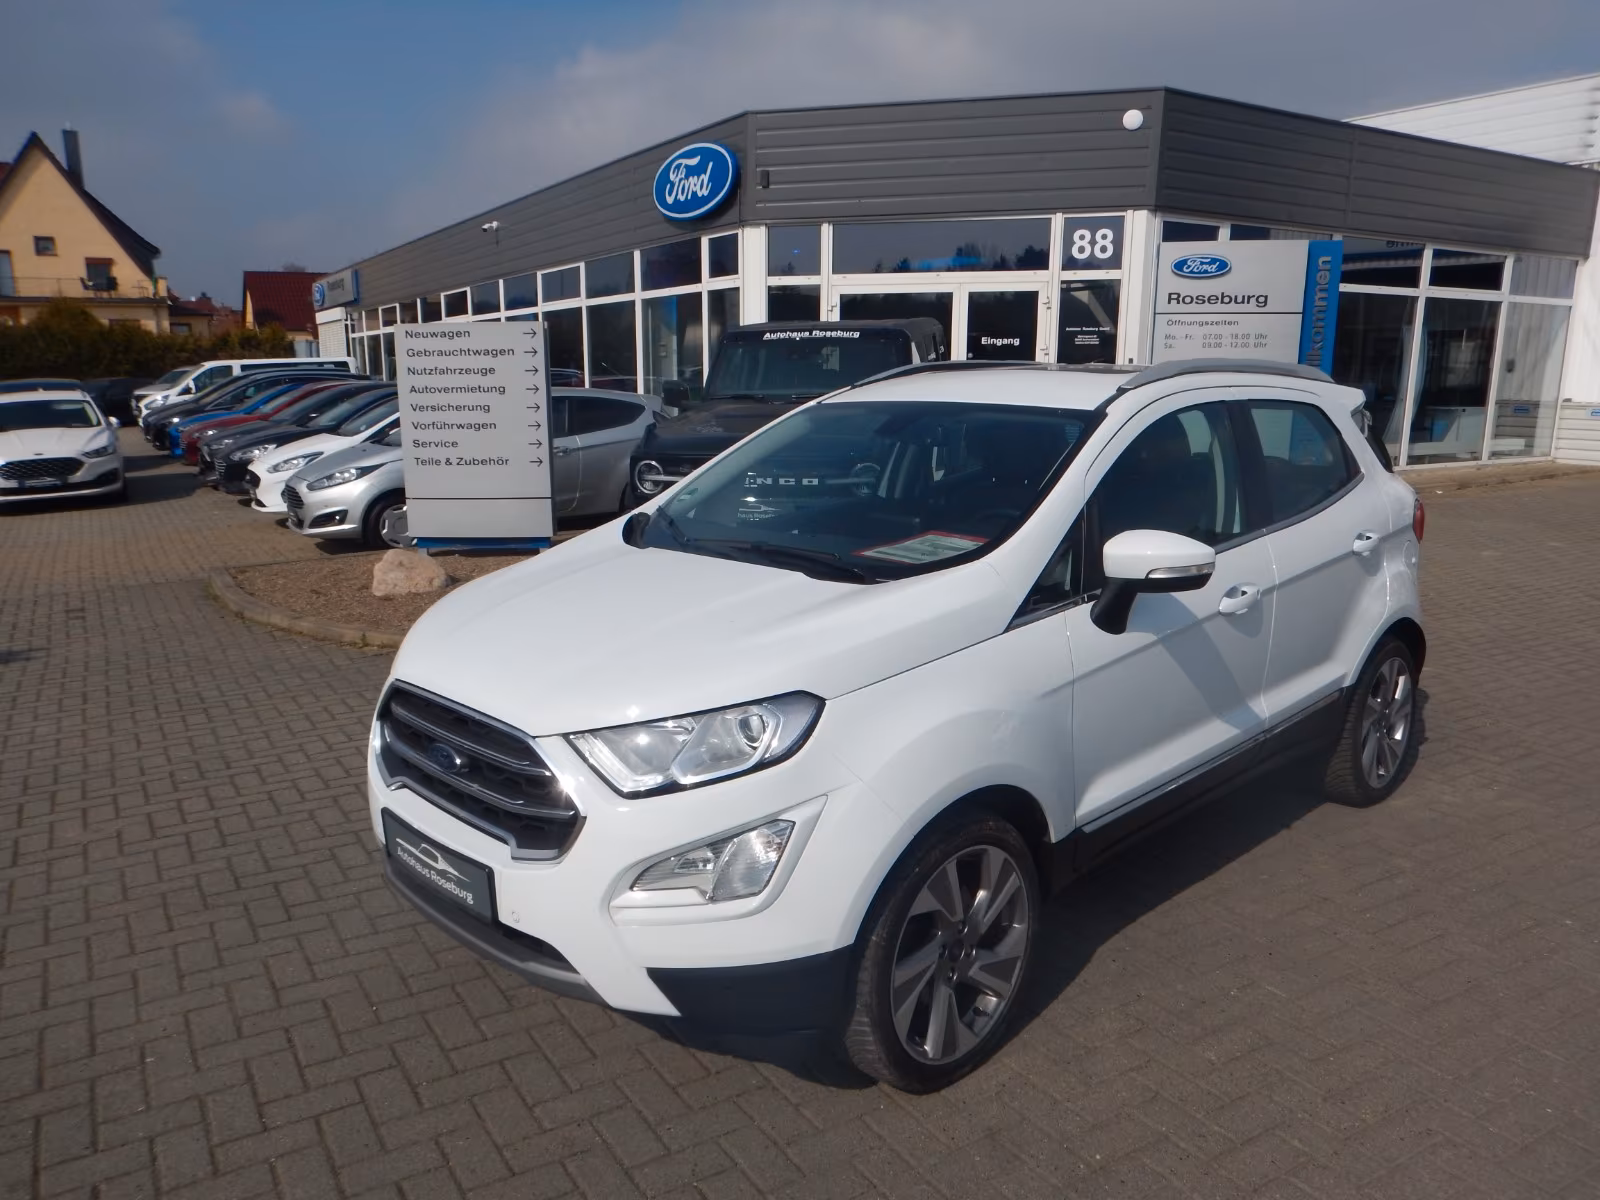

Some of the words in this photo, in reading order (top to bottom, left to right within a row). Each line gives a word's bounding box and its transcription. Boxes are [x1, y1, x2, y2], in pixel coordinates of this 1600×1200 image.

[665, 155, 714, 205] Ford
[1071, 228, 1114, 260] 88
[1183, 257, 1220, 273] Ford
[1167, 292, 1269, 308] Roseburg
[1166, 319, 1239, 327] Öffnungszeiten
[404, 329, 471, 340] Neuwagen
[763, 331, 810, 340] Autohaus
[812, 330, 860, 338] Roseburg
[981, 336, 1020, 346] Eingang
[406, 347, 515, 358] Gebrauchtwagen
[407, 366, 496, 376] Nutzfahrzeuge
[409, 384, 506, 395] Autovermietung
[410, 403, 491, 413] Versicherung
[411, 421, 497, 431] Vorführwagen
[412, 439, 459, 448] Service
[415, 457, 441, 466] Teile
[444, 457, 453, 466] &
[456, 456, 509, 466] Zubehör
[430, 870, 474, 905] Roseburg
